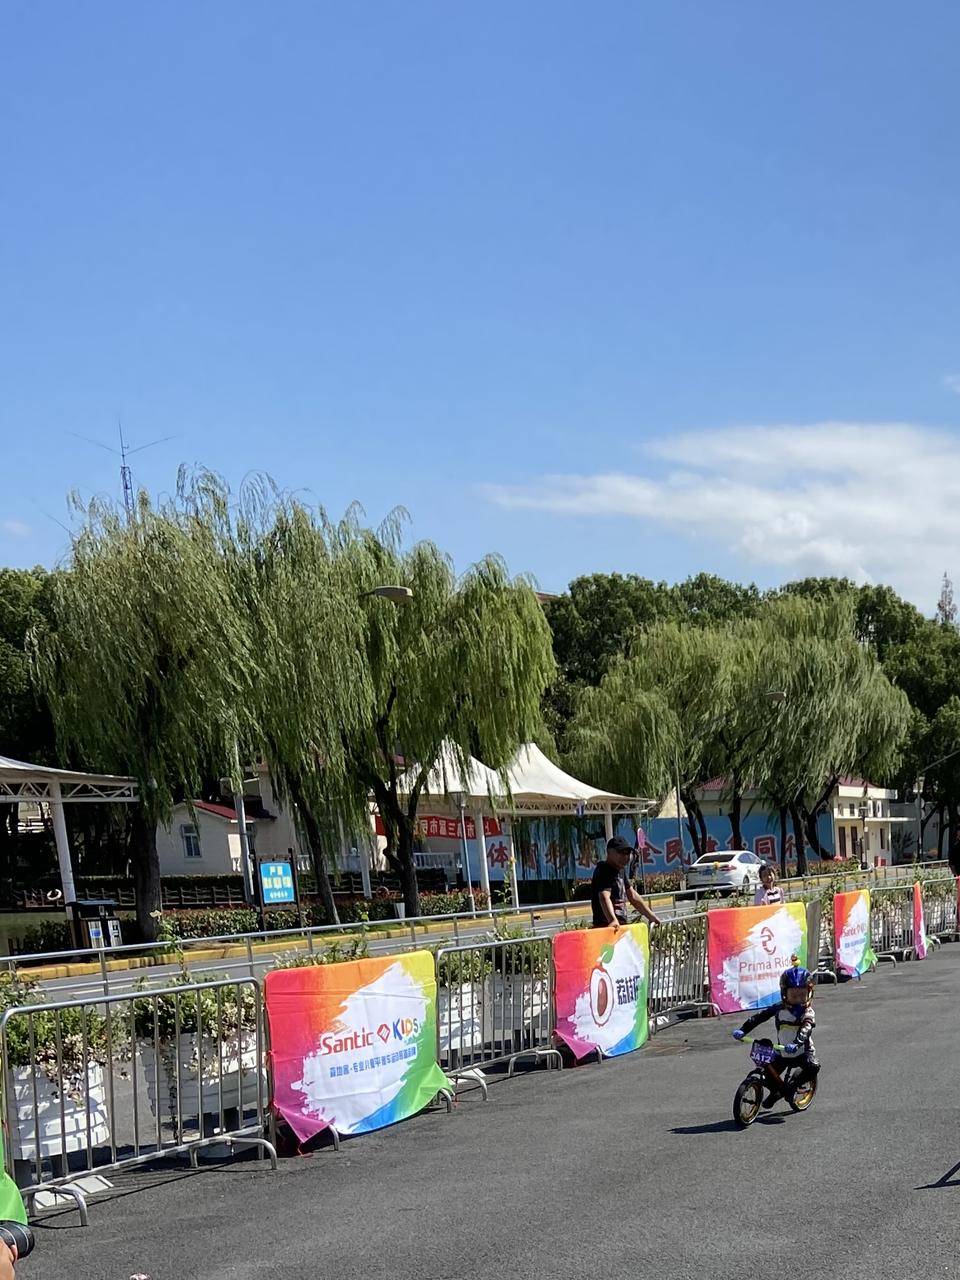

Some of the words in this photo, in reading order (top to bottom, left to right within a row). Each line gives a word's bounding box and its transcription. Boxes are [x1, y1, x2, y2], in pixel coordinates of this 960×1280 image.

[739, 960, 772, 973] Prima
[321, 1027, 374, 1055] Santic
[392, 1018, 419, 1040] KIDS
